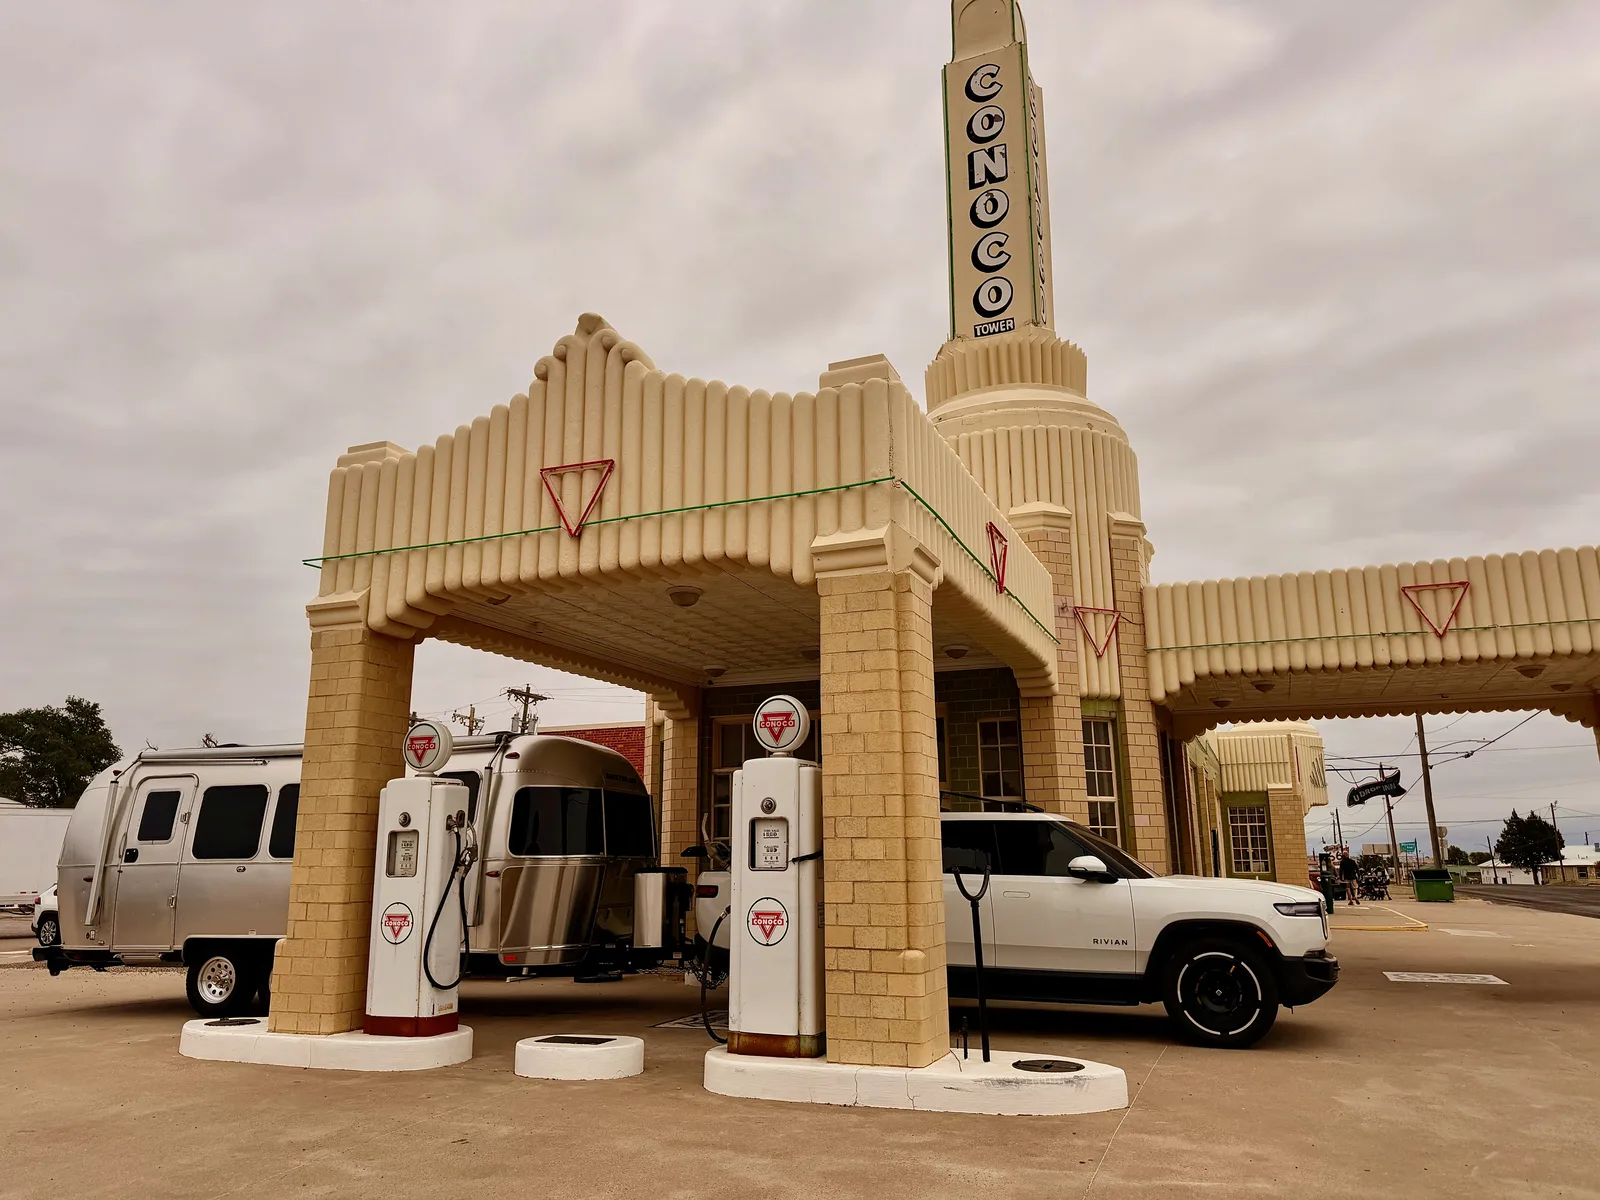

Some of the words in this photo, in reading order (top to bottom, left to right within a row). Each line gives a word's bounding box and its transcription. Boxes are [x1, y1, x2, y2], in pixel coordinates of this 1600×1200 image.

[964, 63, 1014, 319] CONOCO
[974, 319, 1015, 337] TOWER
[760, 720, 794, 728] CONOCO
[1381, 782, 1397, 792] INN
[1092, 938, 1128, 946] RIVIAN
